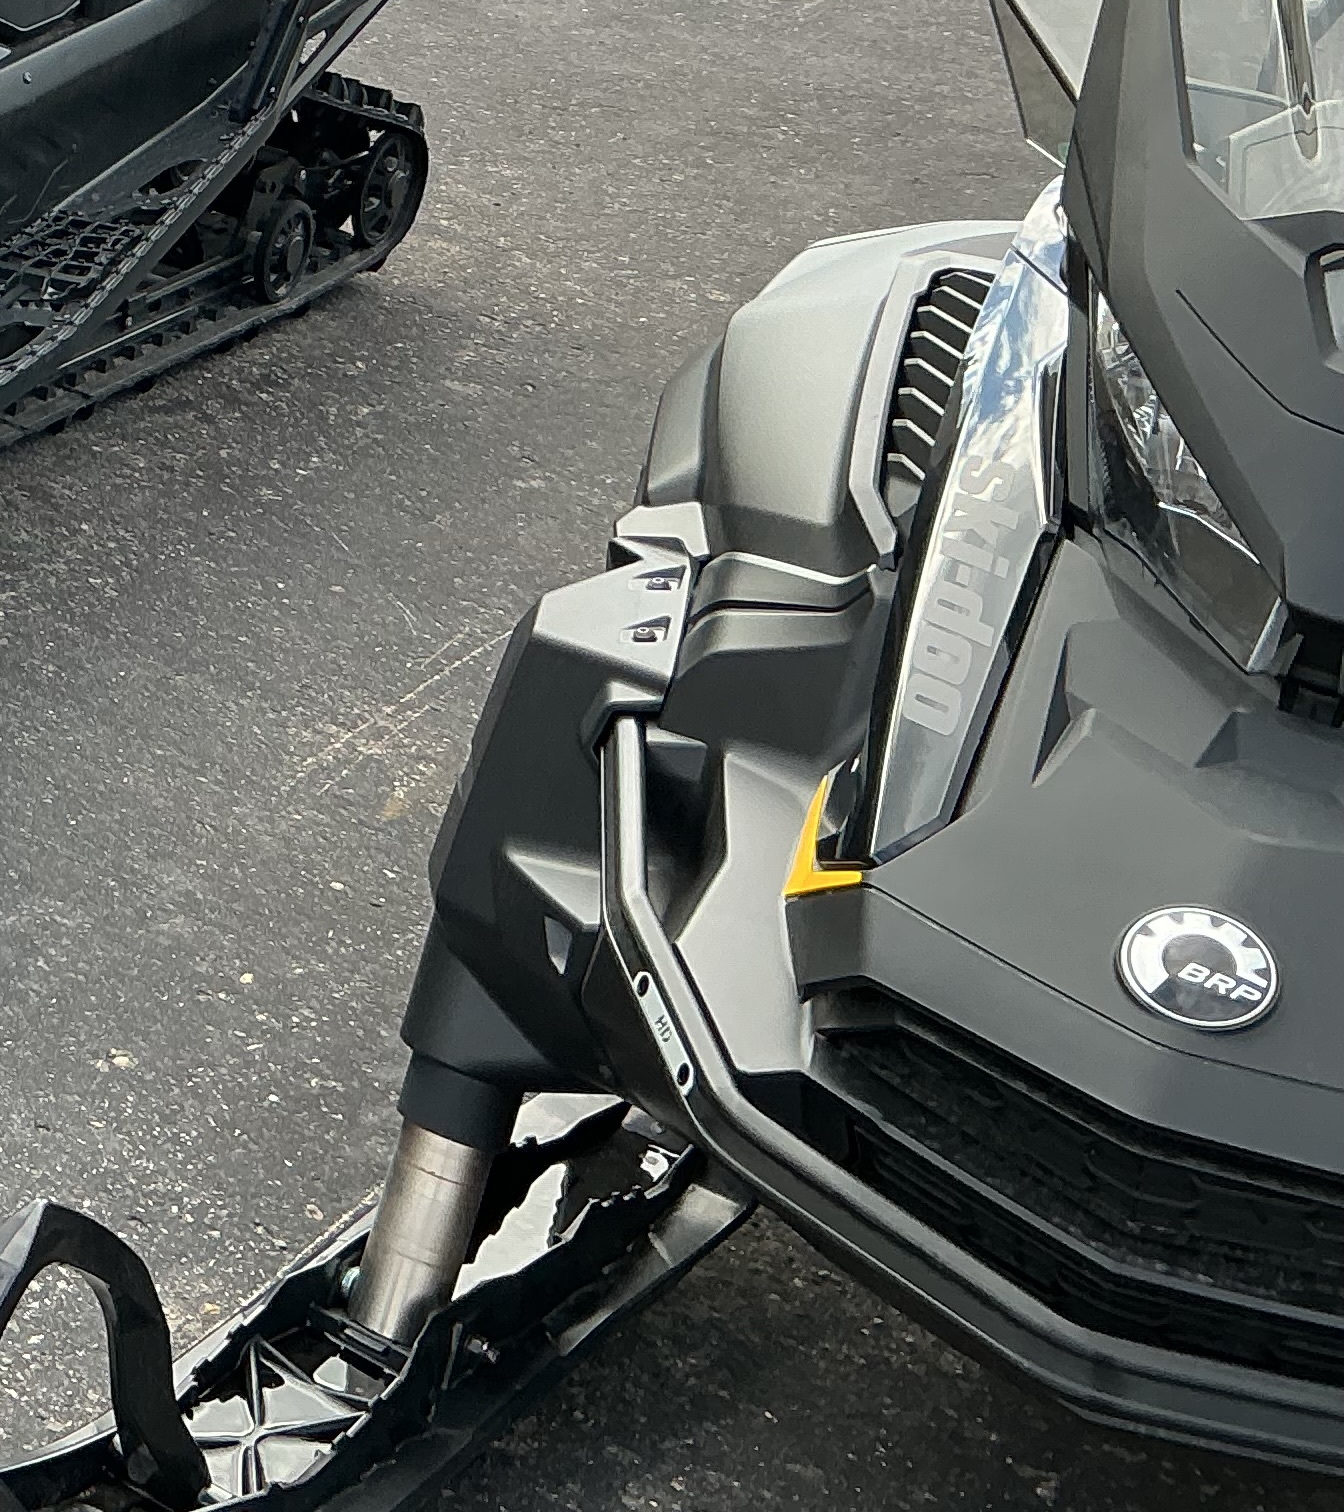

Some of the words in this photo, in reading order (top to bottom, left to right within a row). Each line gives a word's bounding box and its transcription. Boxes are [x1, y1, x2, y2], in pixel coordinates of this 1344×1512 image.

[902, 454, 1020, 736] ski-doo
[1177, 961, 1263, 1002] BRP
[653, 1014, 673, 1043] HD
